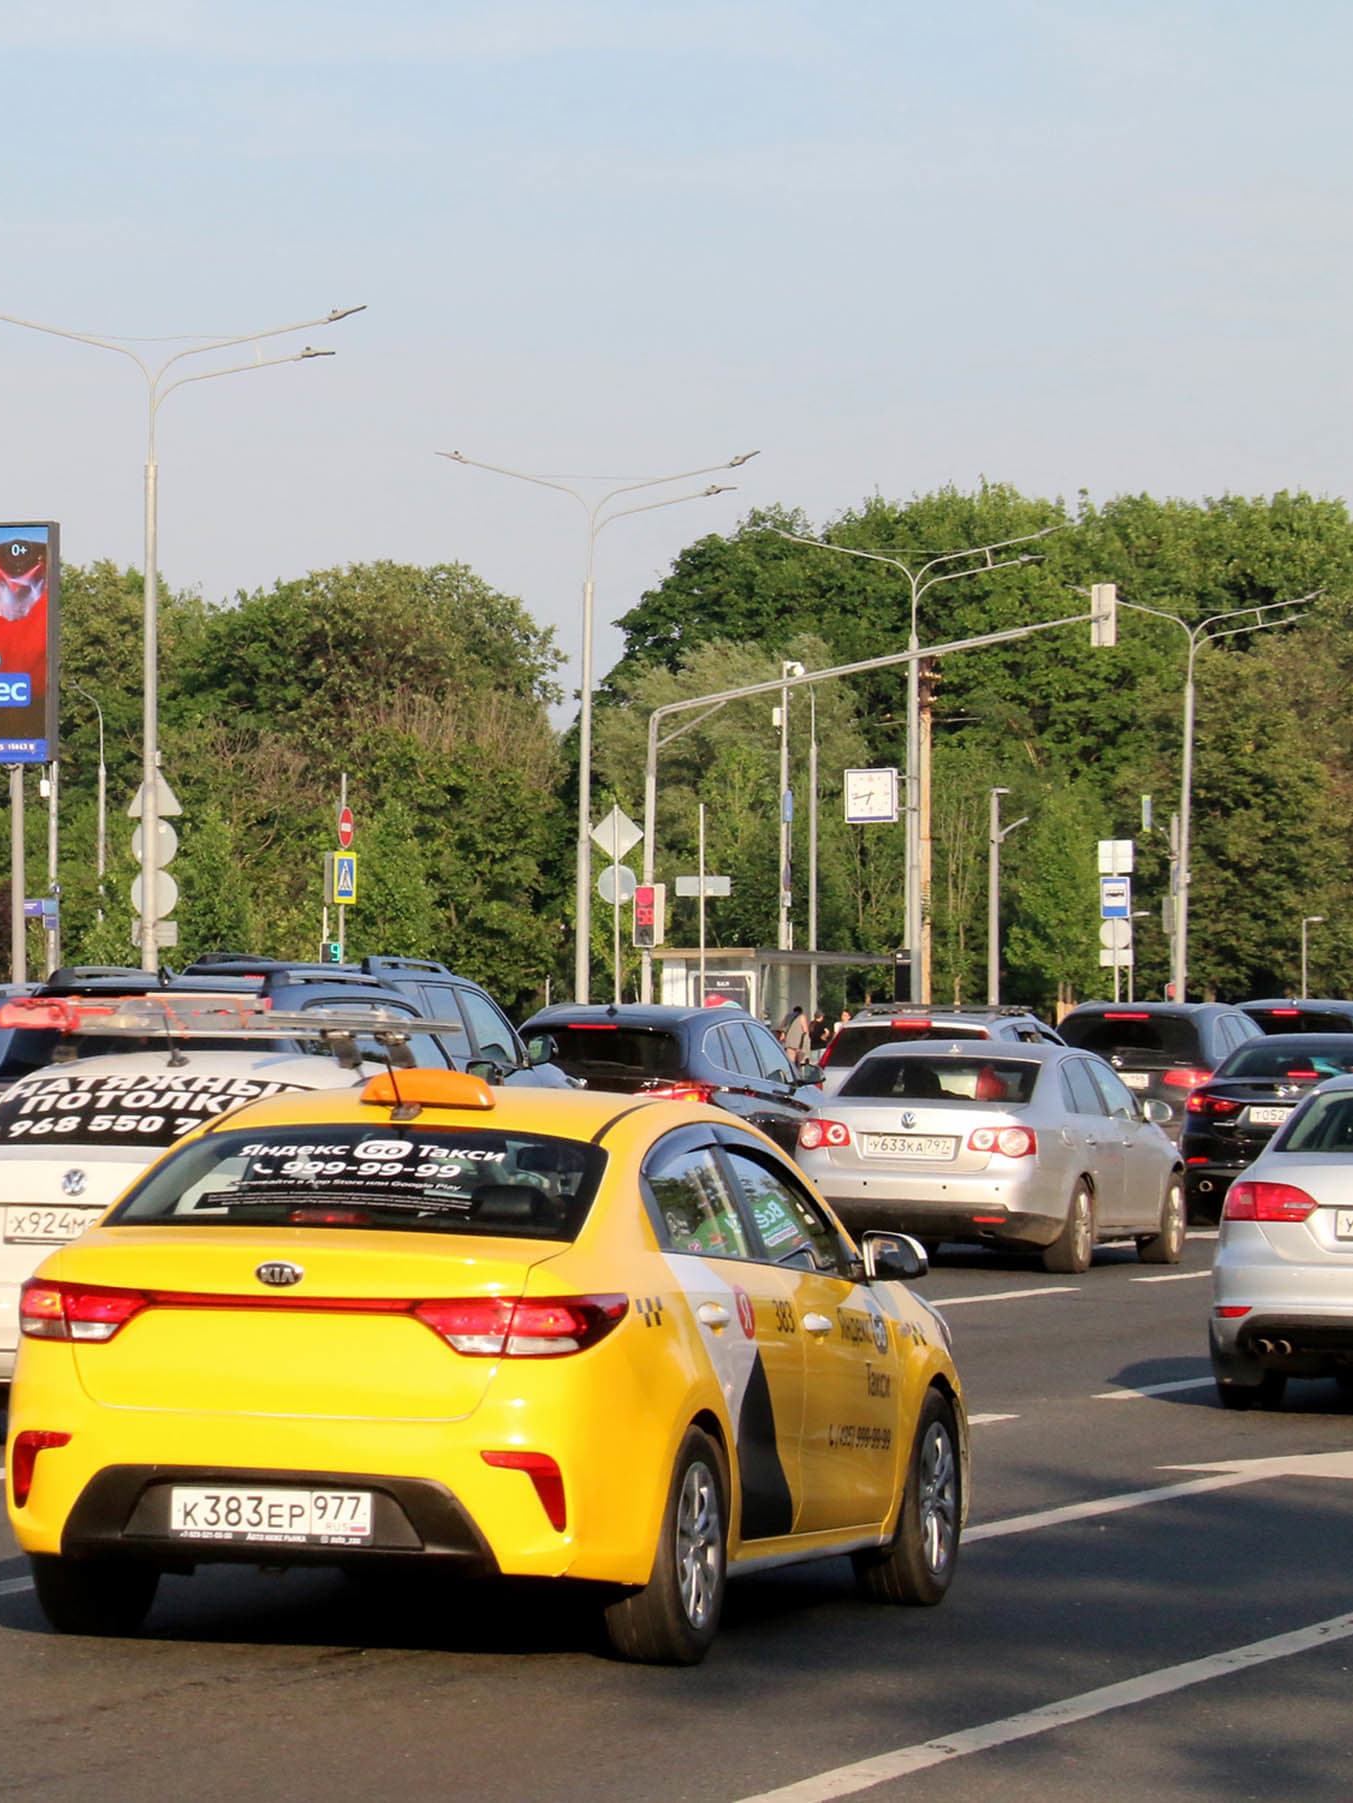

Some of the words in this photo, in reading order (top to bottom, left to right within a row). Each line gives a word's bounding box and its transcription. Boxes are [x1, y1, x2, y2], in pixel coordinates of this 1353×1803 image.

[11, 543, 28, 556] 0+
[330, 943, 341, 961] 9
[9, 1117, 78, 1138] 968
[88, 1115, 163, 1135] 550
[238, 1143, 350, 1158] Яндекс
[418, 1144, 506, 1163] Такси
[280, 1161, 461, 1178] 999-99-99
[391, 1180, 435, 1190] Google
[261, 1267, 295, 1283] KIA
[772, 1299, 795, 1333] 383
[183, 1496, 305, 1528] К383ЕР
[314, 1496, 361, 1520] 977
